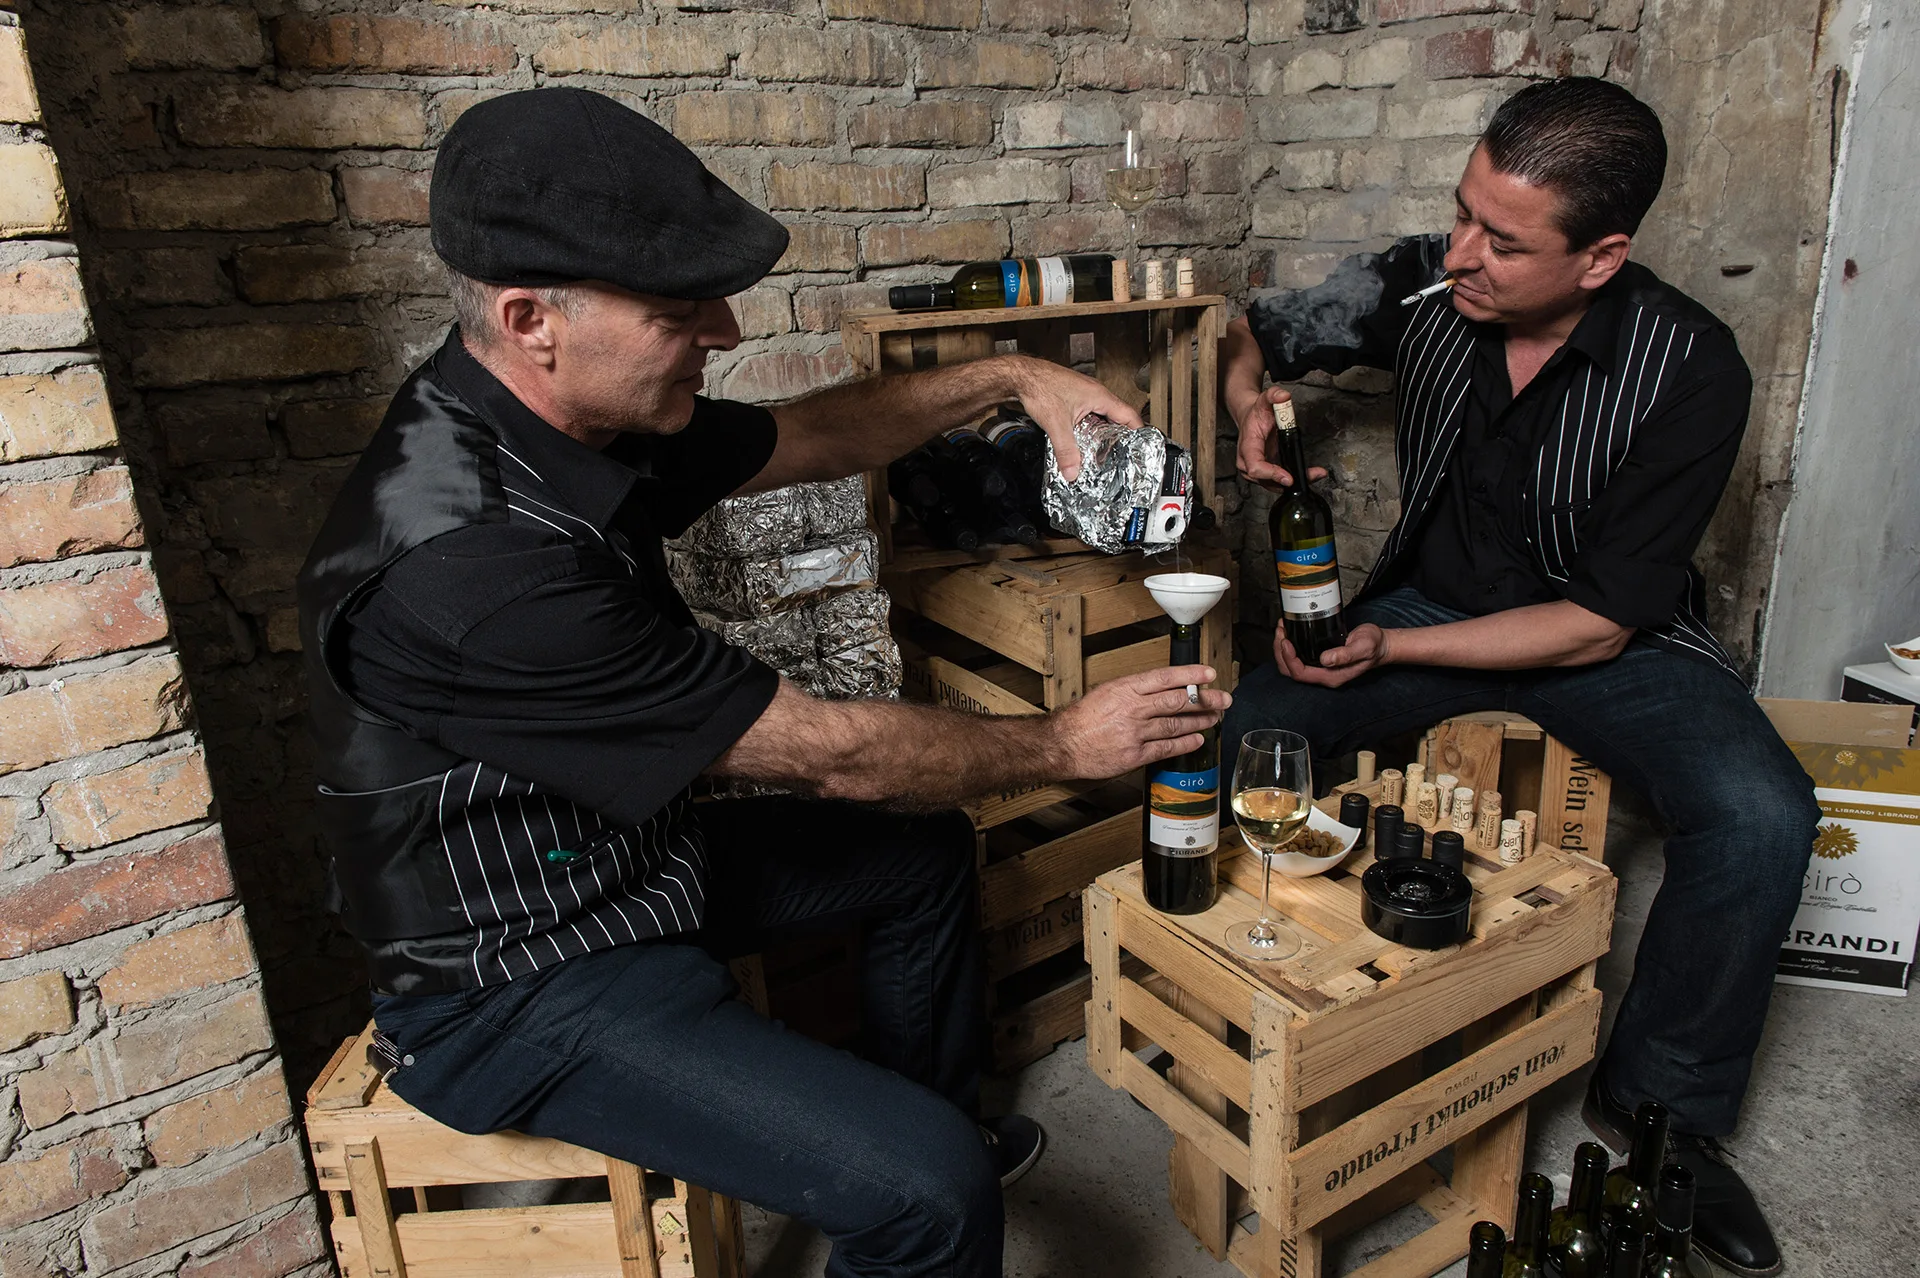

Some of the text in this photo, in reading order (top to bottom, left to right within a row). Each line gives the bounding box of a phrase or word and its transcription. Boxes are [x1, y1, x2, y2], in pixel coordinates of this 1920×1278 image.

[1296, 551, 1318, 562] cirò
[1179, 777, 1205, 787] cirò
[1564, 756, 1598, 812] Wein
[1835, 807, 1875, 816] LIBRANDI
[1877, 811, 1919, 820] LIBRANDI
[1808, 894, 1838, 902] BIANCO
[1005, 918, 1052, 950] Wein
[1425, 1065, 1521, 1130] schenkt
[1324, 1121, 1420, 1193] Freude
